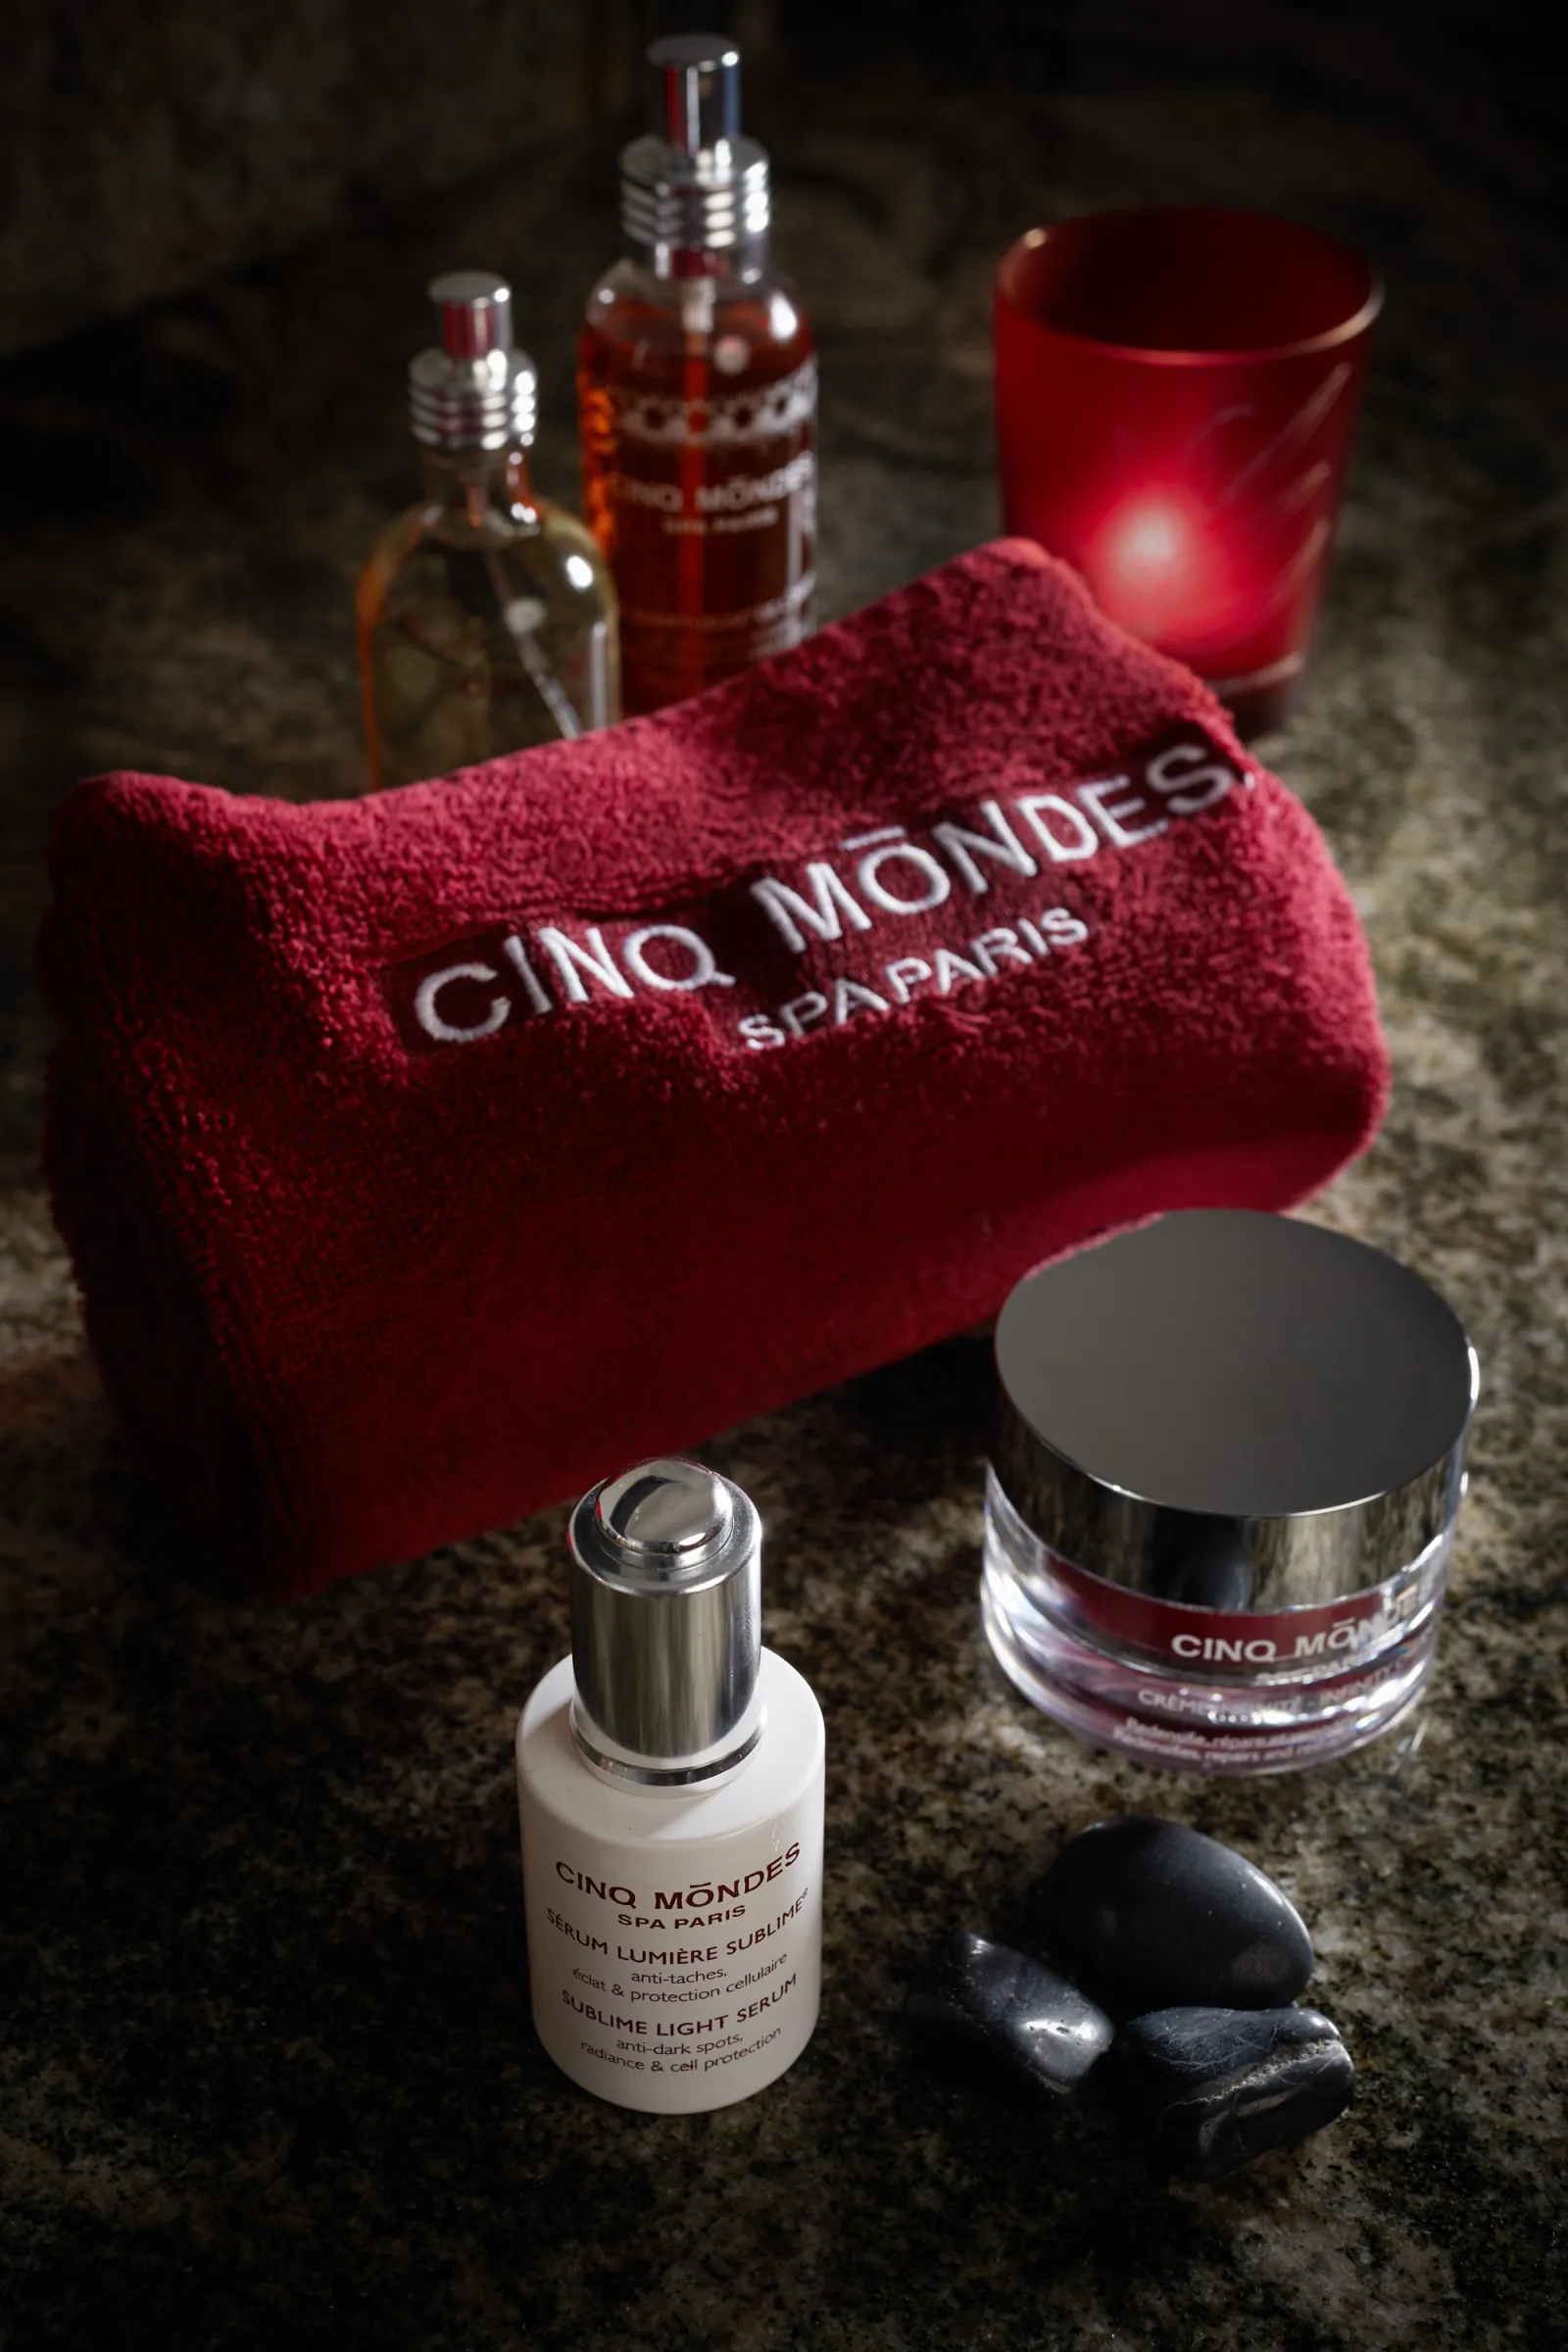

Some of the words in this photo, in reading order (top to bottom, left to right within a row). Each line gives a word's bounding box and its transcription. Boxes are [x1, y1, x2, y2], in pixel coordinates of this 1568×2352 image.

[414, 923, 736, 1044] CINQ
[750, 742, 1233, 953] MŌNDES
[737, 977, 891, 1051] SPA
[886, 906, 1090, 1004] PARIS
[1171, 1634, 1277, 1663] CINQ
[555, 1860, 637, 1910] CINQ
[654, 1841, 801, 1910] MŌNDES
[546, 1907, 609, 1955] SÉRUM
[616, 1945, 718, 1965] LUMIÈRE
[617, 1913, 666, 1930] SPA
[674, 1904, 746, 1930] PARIS
[571, 1967, 608, 1992] éclat
[612, 1984, 625, 1997] &
[630, 1986, 720, 2003] protection
[725, 1953, 788, 1993] cellulaire
[630, 1967, 728, 1984] anti-taches,
[562, 1989, 649, 2035] SUBLIME
[656, 2014, 730, 2036] LIGHT
[736, 1973, 798, 2024] SERUM
[580, 2040, 646, 2071] radiance
[650, 2060, 664, 2073] &
[669, 2059, 699, 2074] cell
[703, 2026, 782, 2072] protection
[615, 2037, 692, 2056] anti-dark
[696, 2032, 744, 2055] spots,
